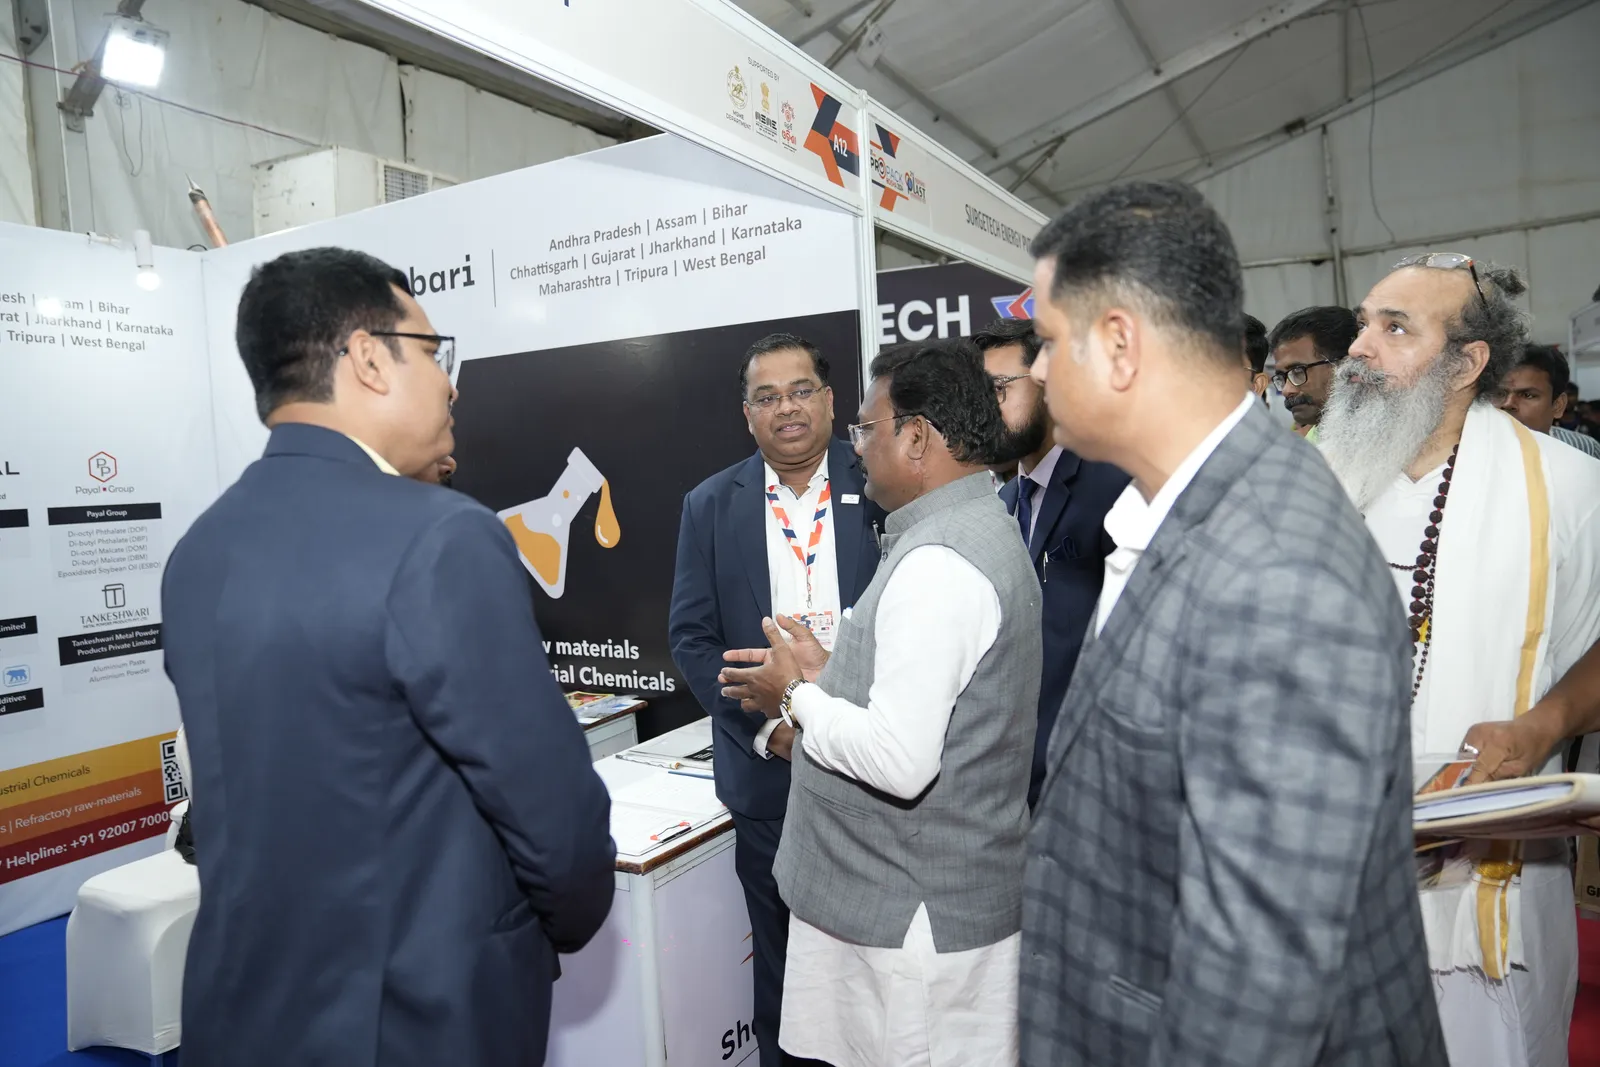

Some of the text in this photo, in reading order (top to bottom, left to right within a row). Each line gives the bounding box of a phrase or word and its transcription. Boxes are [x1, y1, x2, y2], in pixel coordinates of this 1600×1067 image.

[747, 56, 774, 79] SUPPORTED
[833, 134, 848, 157] A12
[549, 204, 748, 252] Andhra Pradesh Assam Bihar
[965, 203, 1001, 239] SURGETECH
[1001, 223, 1021, 249] ENERGY
[510, 217, 803, 280] Chhattisgarh Gujarat Jharkhand Karnataka
[409, 254, 475, 297] bari
[538, 245, 766, 297] Maharashtra Tripura West Bengal
[0, 292, 26, 304] esh
[98, 301, 130, 315] Bihar
[35, 314, 102, 330] Jharkhand
[116, 321, 174, 336] Karnataka
[877, 295, 971, 345] ECH
[7, 329, 146, 352] Tripura West Bengal
[75, 485, 135, 496] Payal Group
[86, 509, 128, 518] Payal Group
[128, 526, 147, 534] (DOP)
[69, 539, 96, 547] Di-butyl
[58, 568, 97, 578] Epoxidized
[98, 566, 127, 576] Soybean
[128, 563, 138, 571] Oil
[0, 622, 26, 632] imited
[80, 607, 150, 625] TANKESHWARI
[72, 629, 160, 647] Tankeshwari Metal Powder
[77, 638, 157, 656] Products Private Limited
[555, 639, 640, 660] materials
[89, 668, 150, 683] Aluminium Powder
[92, 663, 128, 673] Aluminium
[579, 665, 676, 692] Chemicals
[33, 765, 91, 787] Chemicals
[15, 807, 72, 829] Refractory
[74, 787, 142, 813] raw-materials
[6, 843, 68, 869] Helpline:
[70, 833, 95, 848] +91
[98, 820, 137, 841] 92007
[140, 811, 171, 828] 7000
